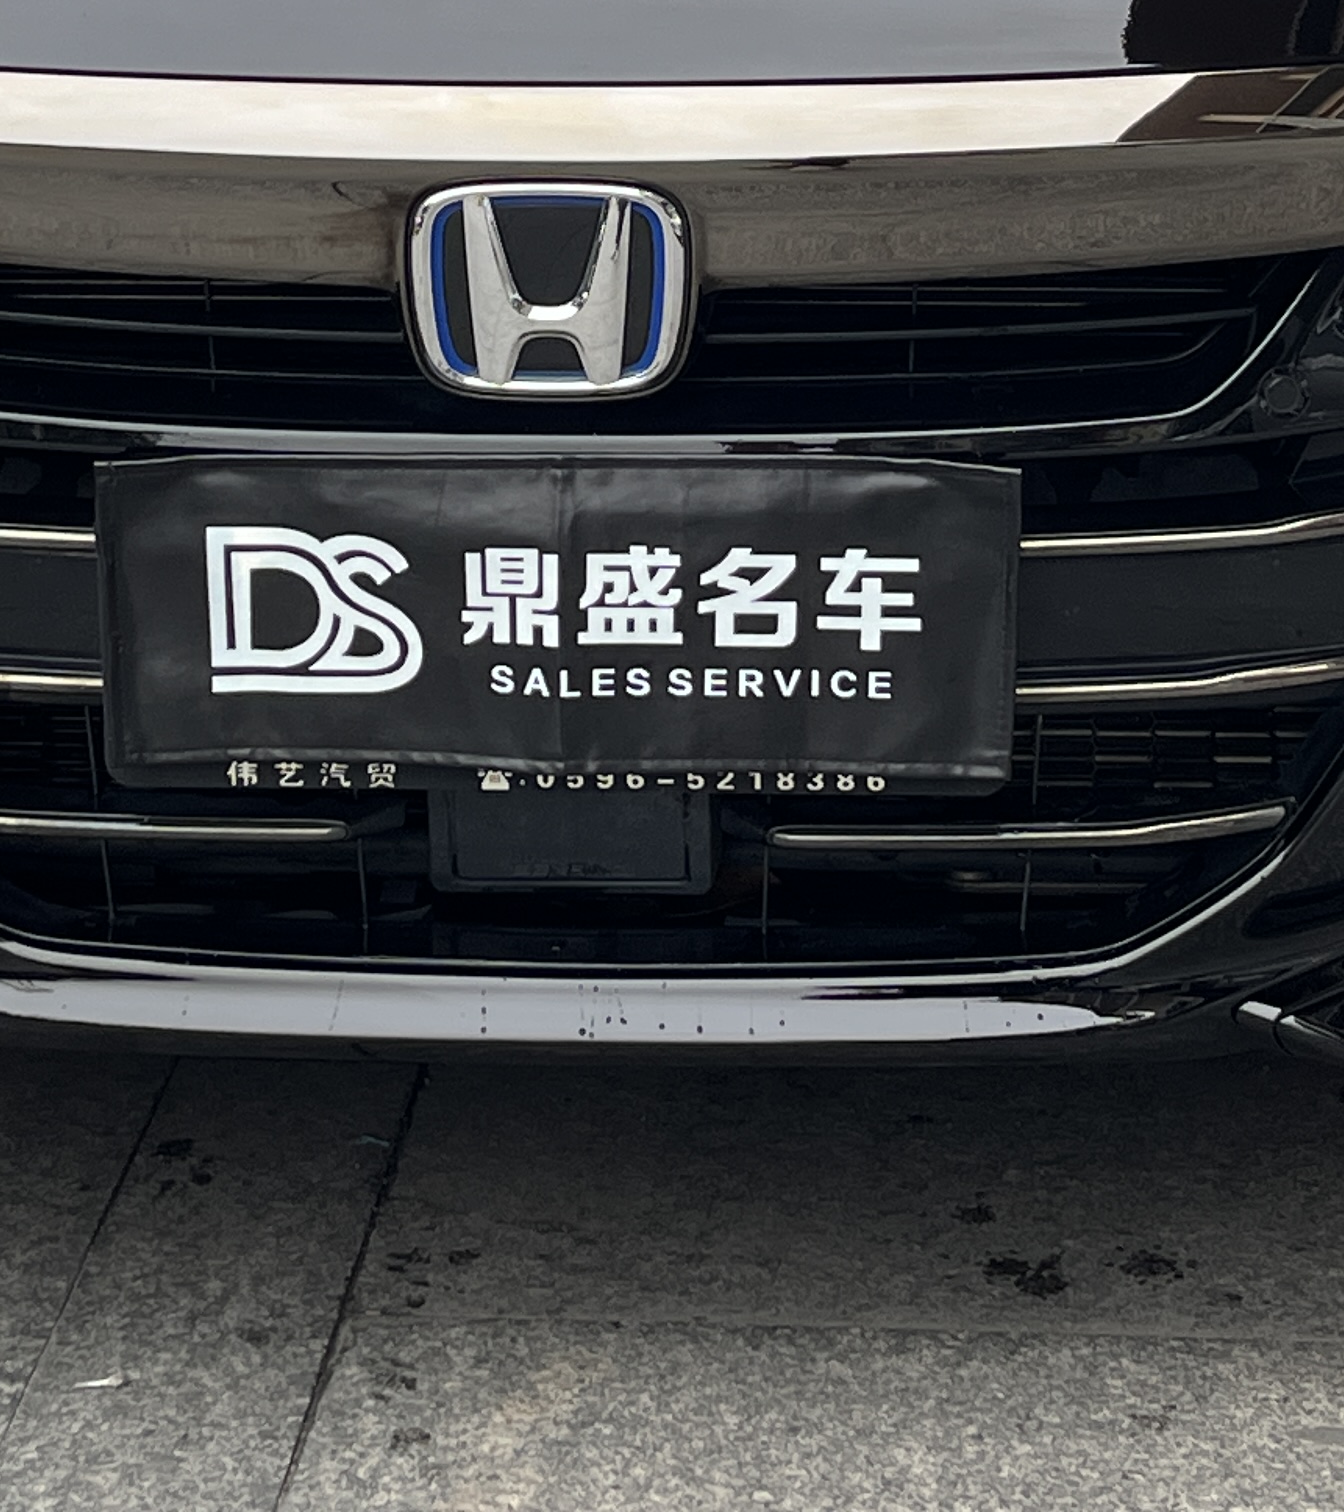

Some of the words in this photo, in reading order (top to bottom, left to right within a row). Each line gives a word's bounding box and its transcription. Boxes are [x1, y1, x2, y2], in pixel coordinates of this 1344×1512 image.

[205, 525, 423, 694] DS
[460, 545, 922, 652] 鼎盛名车
[490, 664, 651, 699] SALES
[667, 666, 894, 700] SERVICE
[226, 760, 397, 789] 伟艺汽贸
